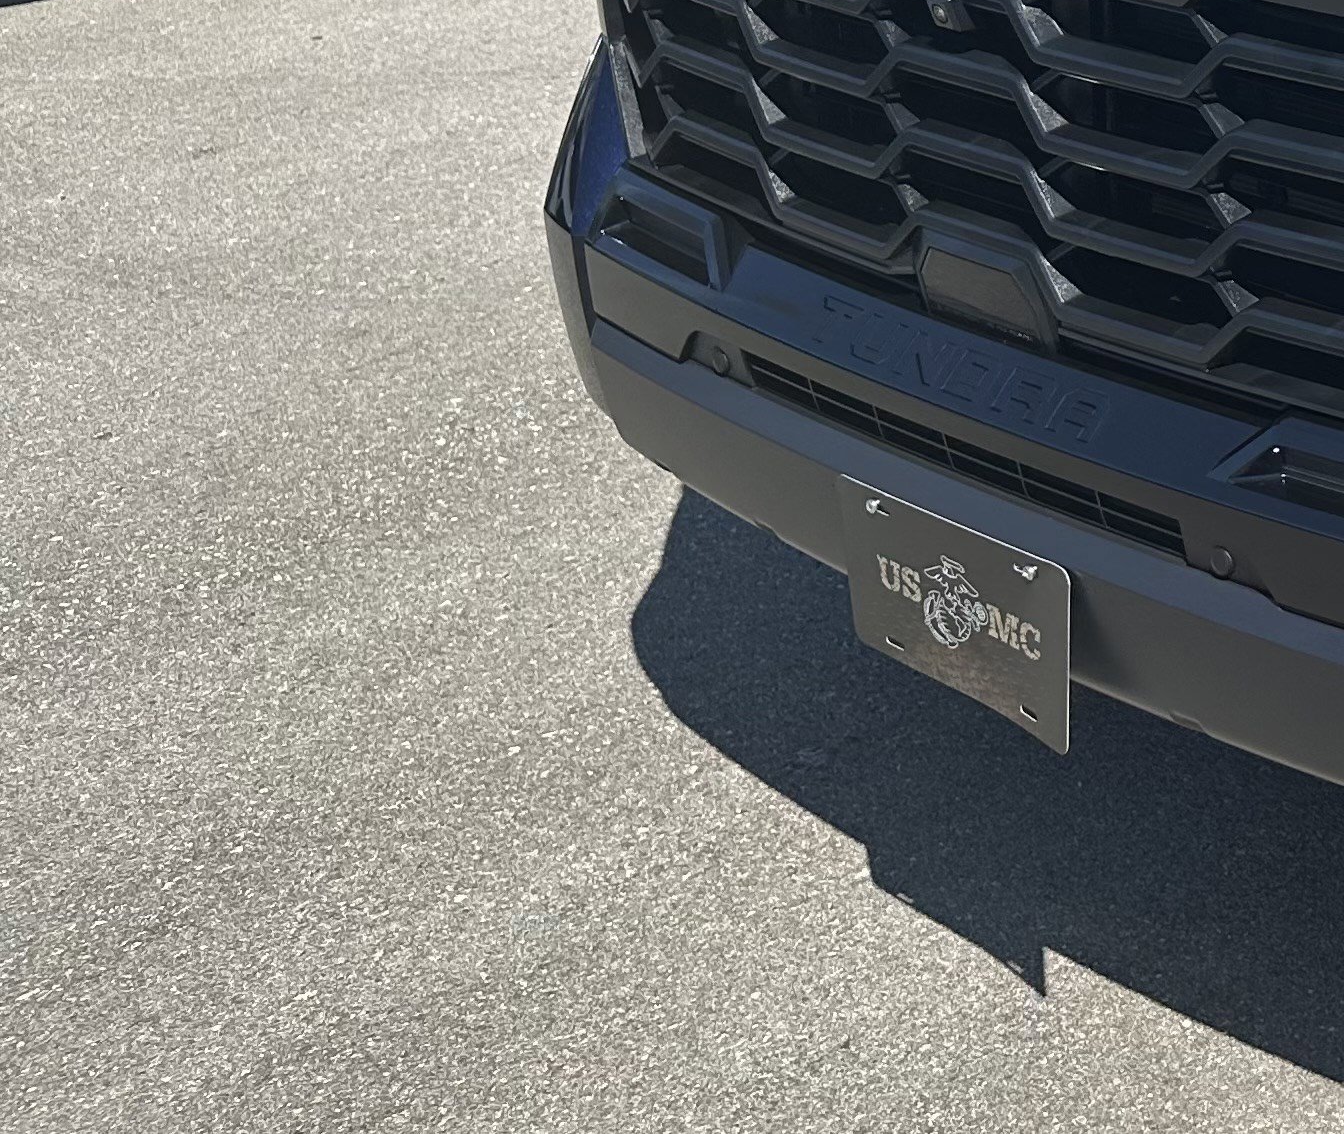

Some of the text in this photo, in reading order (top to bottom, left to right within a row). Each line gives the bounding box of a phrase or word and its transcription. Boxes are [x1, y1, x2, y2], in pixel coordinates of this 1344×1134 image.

[812, 295, 1112, 444] TUNDRA
[876, 553, 1042, 661] US MC
